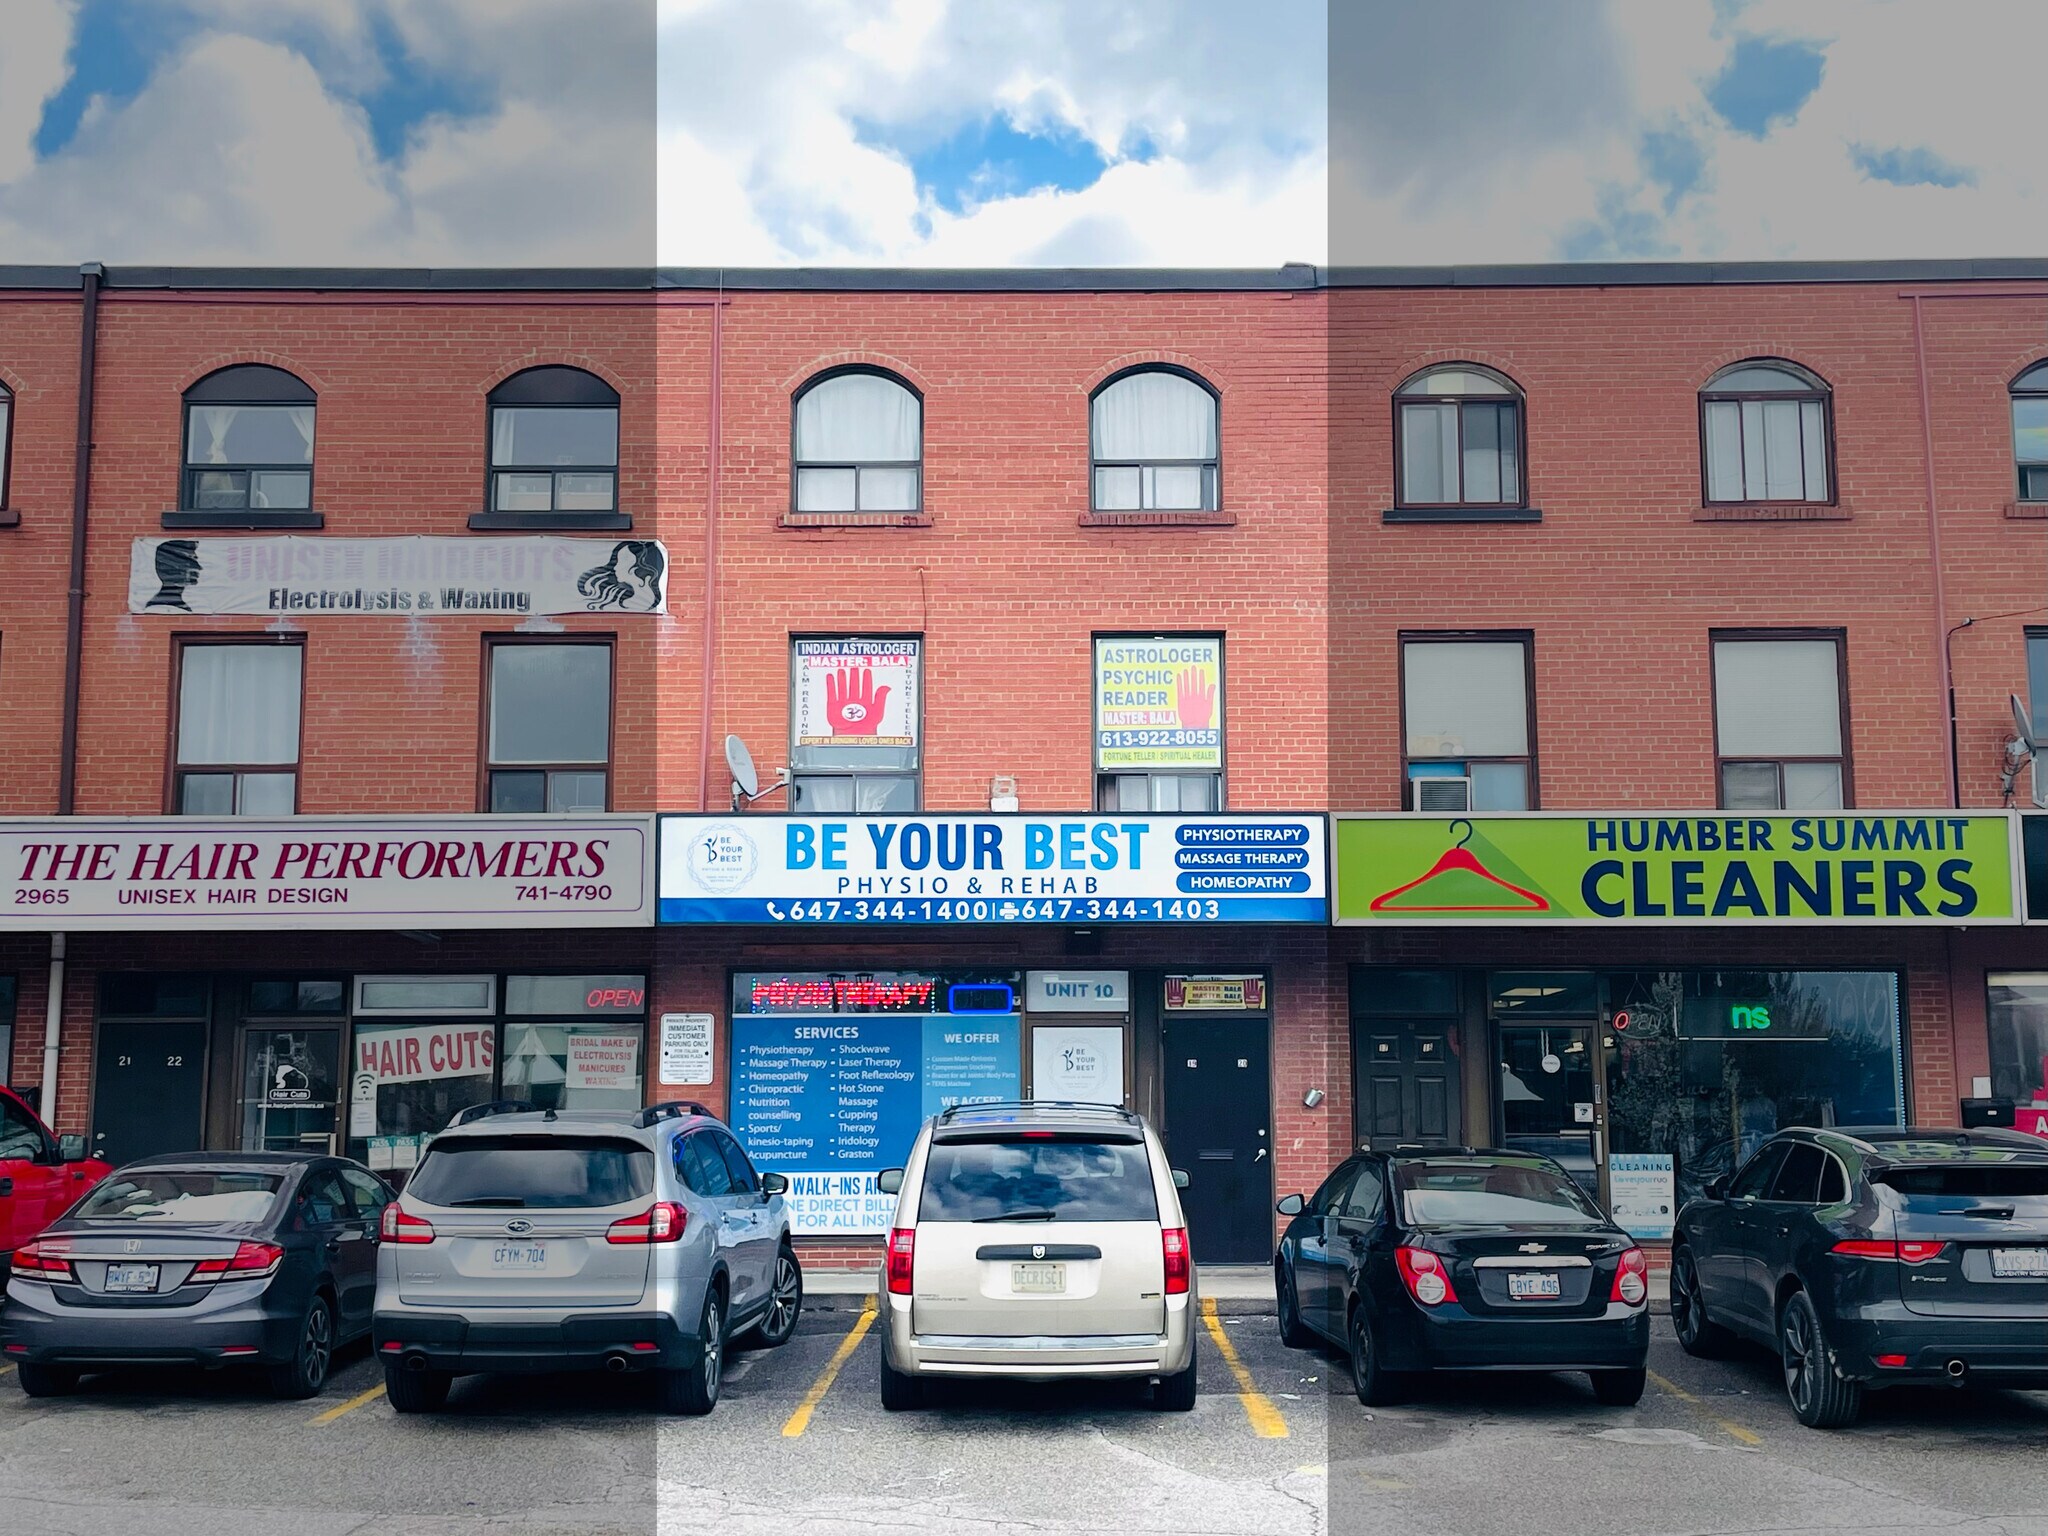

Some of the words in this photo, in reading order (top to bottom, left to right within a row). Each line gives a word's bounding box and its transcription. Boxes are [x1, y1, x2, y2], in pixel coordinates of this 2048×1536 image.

[226, 544, 364, 582] UNISEX
[377, 543, 575, 582] HAIRCUTS
[268, 587, 412, 612] Electrolysis
[417, 589, 435, 610] &
[440, 587, 531, 613] Waxing
[801, 643, 839, 655] INDIAN
[842, 643, 914, 655] ASTROLOGER
[810, 656, 868, 667] MASTER:
[871, 655, 908, 667] BALA
[1103, 648, 1214, 664] ASTROLOGER
[1103, 670, 1174, 685] PSYCHIC
[1103, 691, 1168, 706] READER
[1104, 711, 1147, 725] MASTER:
[1149, 711, 1176, 724] BALA
[895, 737, 911, 745] BACK
[1101, 730, 1217, 747] 613-922-8055
[1103, 752, 1132, 761] FORTUNE
[1133, 751, 1156, 761] TELLER
[1159, 751, 1191, 761] SPIRITUAL
[1191, 750, 1217, 761] HEALER
[720, 836, 732, 844] BE
[1183, 829, 1302, 841] PHYSIOTHERAPY
[1587, 820, 1775, 852] HUMBER
[1791, 819, 1969, 851] SUMMIT
[720, 845, 743, 853] YOUR
[786, 823, 848, 870] BE
[866, 822, 1004, 871] YOUR
[1025, 822, 1150, 871] BEST
[18, 843, 120, 881] THE
[127, 843, 259, 881] HAIR
[271, 839, 610, 880] PERFORMERS
[720, 855, 742, 863] BEST
[1179, 853, 1242, 864] MASSAGE
[1244, 853, 1304, 864] THERAPY
[838, 877, 949, 894] PHYSIO
[967, 876, 983, 894] &
[1002, 876, 1099, 894] REHAB
[1190, 876, 1293, 889] HOMEOPATHY
[1580, 858, 1978, 918] CLEANERS
[14, 889, 70, 905] 2965
[118, 889, 197, 905] UNISEX
[208, 889, 257, 904] HAIR
[268, 888, 348, 904] DESIGN
[515, 885, 612, 901] 741-4790
[789, 900, 988, 921] 647-344-1400
[1021, 899, 1220, 920] 647-344-1403
[1045, 983, 1089, 997] UNIT
[1094, 984, 1114, 998] 10
[586, 988, 644, 1008] OPEN
[1731, 1004, 1771, 1029] ns
[794, 1026, 859, 1039] SERVICES
[944, 1033, 962, 1043] WE
[964, 1033, 1000, 1043] OFFER
[570, 1038, 599, 1047] BRIDAL
[600, 1038, 624, 1047] MAKE
[626, 1039, 637, 1047] UP
[361, 1037, 423, 1078] HAIR
[429, 1029, 494, 1073] CUTS
[749, 1045, 814, 1056] Physiotherapy
[839, 1044, 891, 1054] Shockwave
[118, 1055, 131, 1066] 21
[573, 1050, 632, 1060] ELECTROLYSIS
[167, 1056, 182, 1066] 22
[749, 1059, 789, 1069] Massage
[790, 1058, 828, 1069] Therapy
[838, 1057, 864, 1067] Laser
[864, 1057, 902, 1068] Therapy
[578, 1064, 626, 1073] MANICURES
[749, 1071, 809, 1082] Homeopathy
[838, 1070, 860, 1080] Foot
[861, 1070, 915, 1081] Reflexology
[748, 1084, 805, 1095] Chiropractic
[838, 1083, 856, 1093] Hot
[859, 1083, 885, 1093] Stone
[748, 1097, 790, 1107] Nutrition
[838, 1097, 879, 1107] Massage
[940, 1096, 959, 1106] WE
[748, 1110, 802, 1121] counselling
[838, 1110, 878, 1121] Cupping
[747, 1123, 782, 1134] Sports/
[838, 1123, 876, 1134] Therapy
[747, 1136, 814, 1147] kinesio-taping
[838, 1136, 880, 1147] Iridology
[747, 1150, 808, 1160] Acupuncture
[838, 1149, 874, 1159] Graston
[1610, 1163, 1672, 1171] CLEANING
[793, 1176, 861, 1196] WALK-INS
[809, 1199, 862, 1212] DIRECT
[865, 1198, 894, 1212] BILL
[797, 1214, 828, 1227] FOR
[832, 1214, 858, 1227] ALL
[526, 1248, 545, 1263] 704
